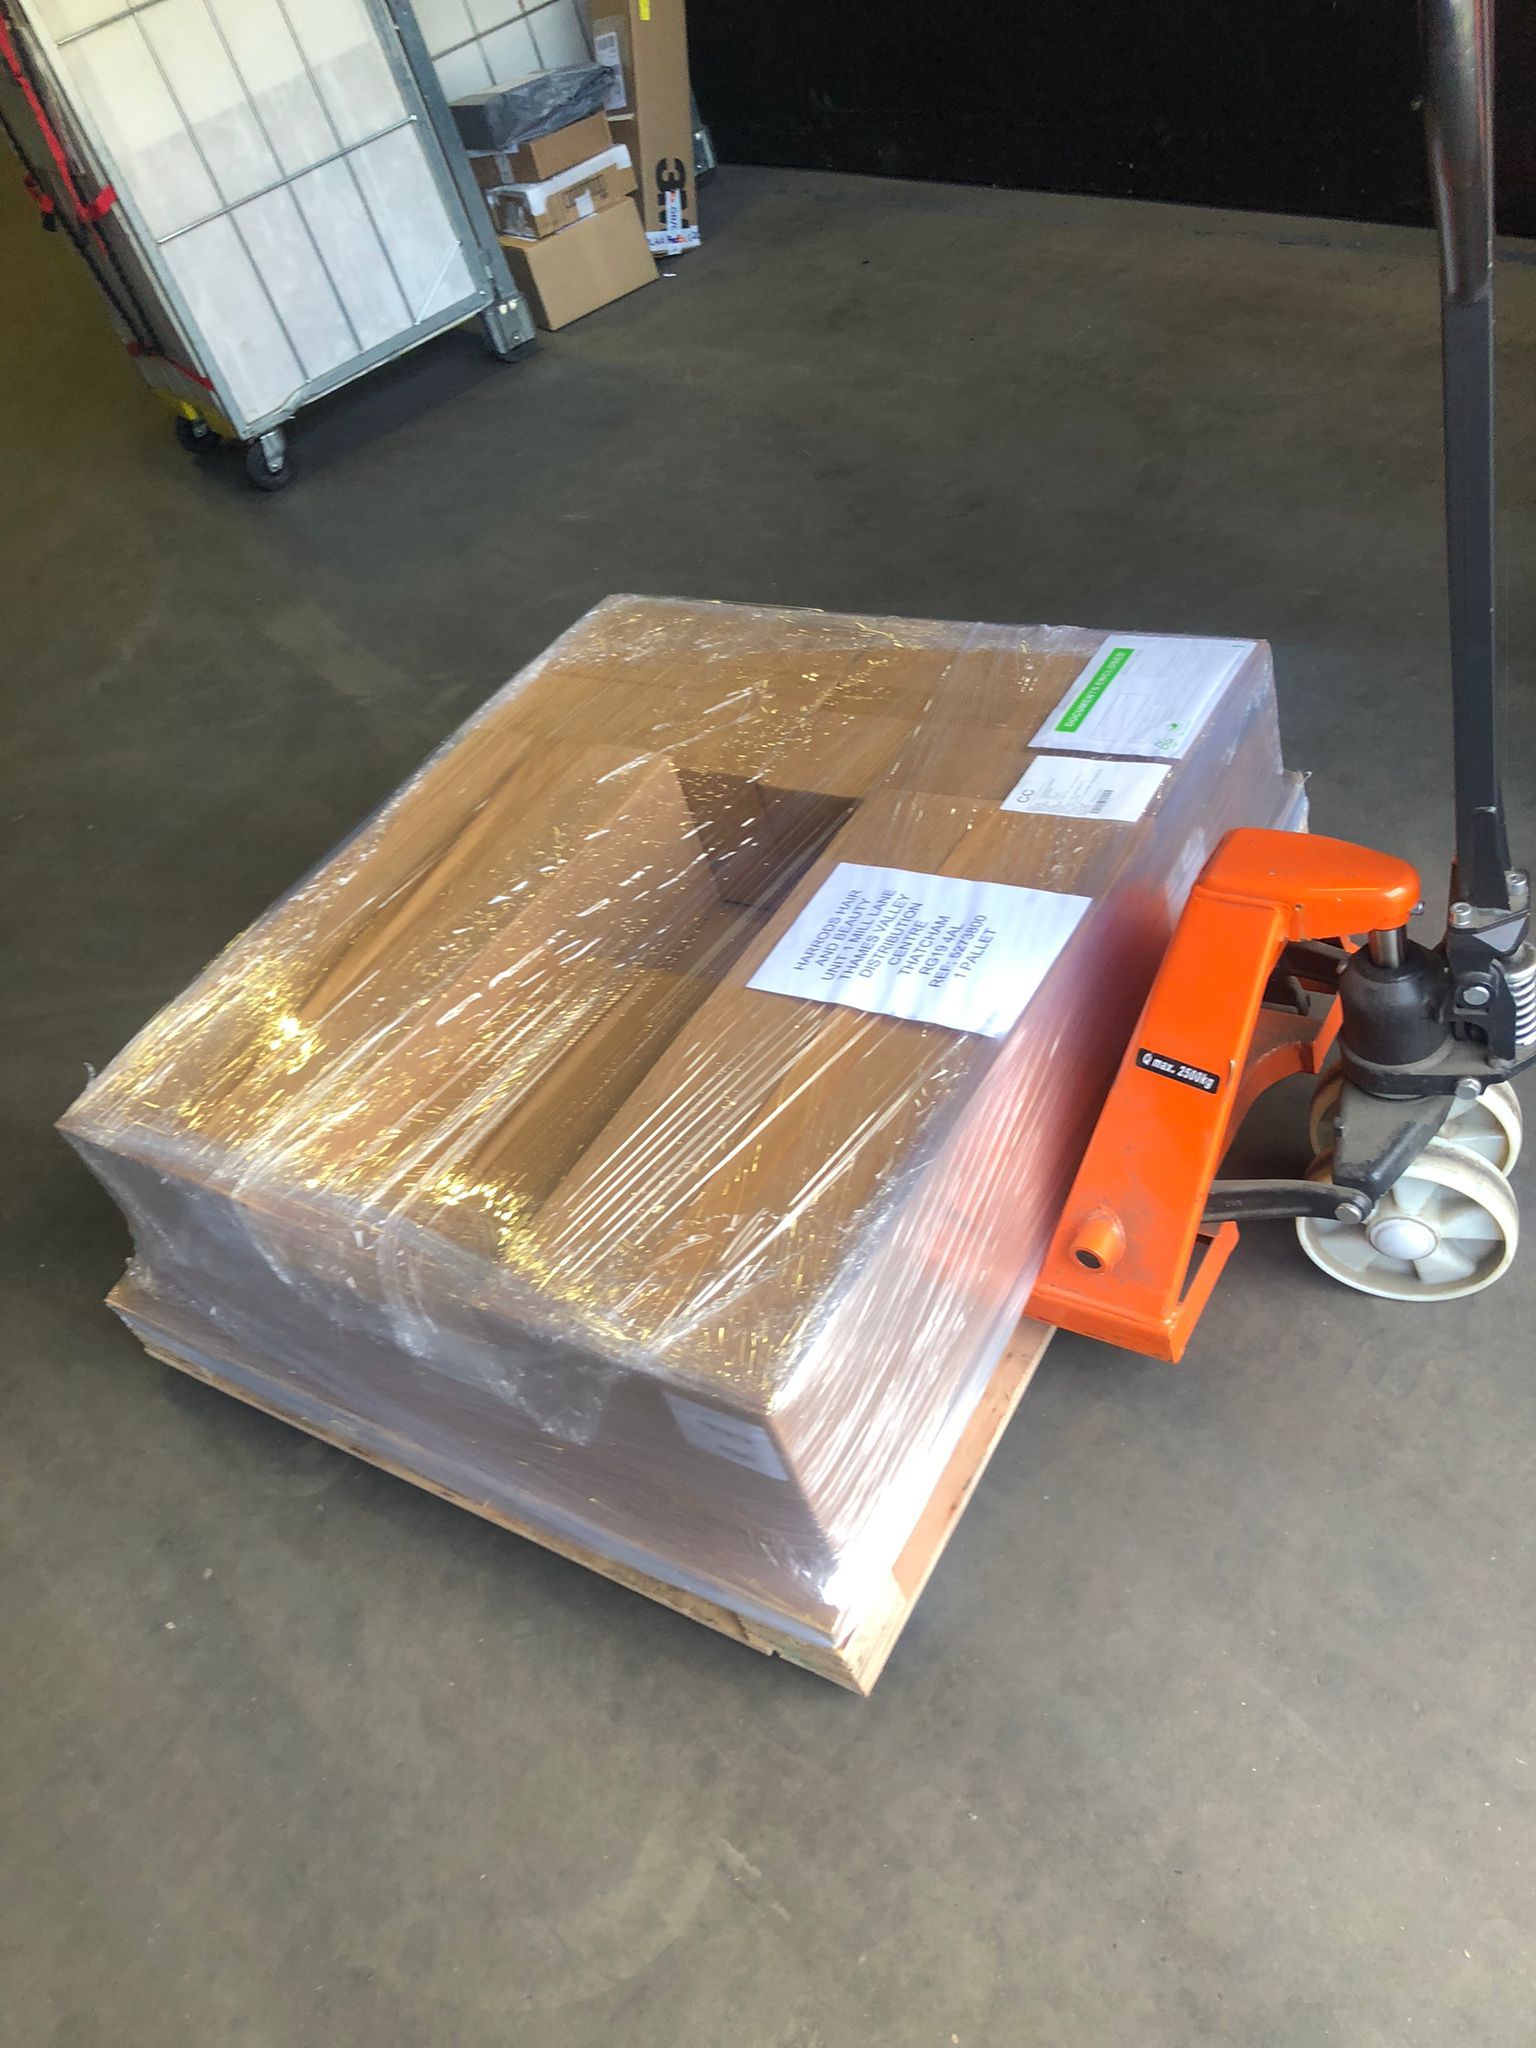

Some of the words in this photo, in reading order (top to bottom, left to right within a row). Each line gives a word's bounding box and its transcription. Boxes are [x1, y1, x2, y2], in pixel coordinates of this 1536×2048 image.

[1062, 686, 1102, 727] DOCUMENTS
[1093, 651, 1127, 685] ENCLOSED
[793, 917, 842, 971] HARRODS
[834, 889, 863, 915] HAIR
[814, 942, 839, 967] AND
[832, 898, 871, 941] BEAUTY
[820, 955, 848, 981] UNIT
[847, 919, 875, 943] MILL
[867, 889, 897, 917] LANE
[837, 935, 880, 980] THAMES
[872, 893, 910, 932] VALLEY
[858, 902, 923, 978] DISTRIBUTION
[887, 920, 929, 966] CENTRE
[897, 915, 951, 975] THATCHAM
[918, 944, 949, 975] RG19
[942, 924, 965, 943] 4AL
[959, 927, 997, 971] PALLET
[1142, 1053, 1153, 1066] Q
[1151, 1059, 1176, 1074] max.
[1177, 1066, 1215, 1089] 2500kg
